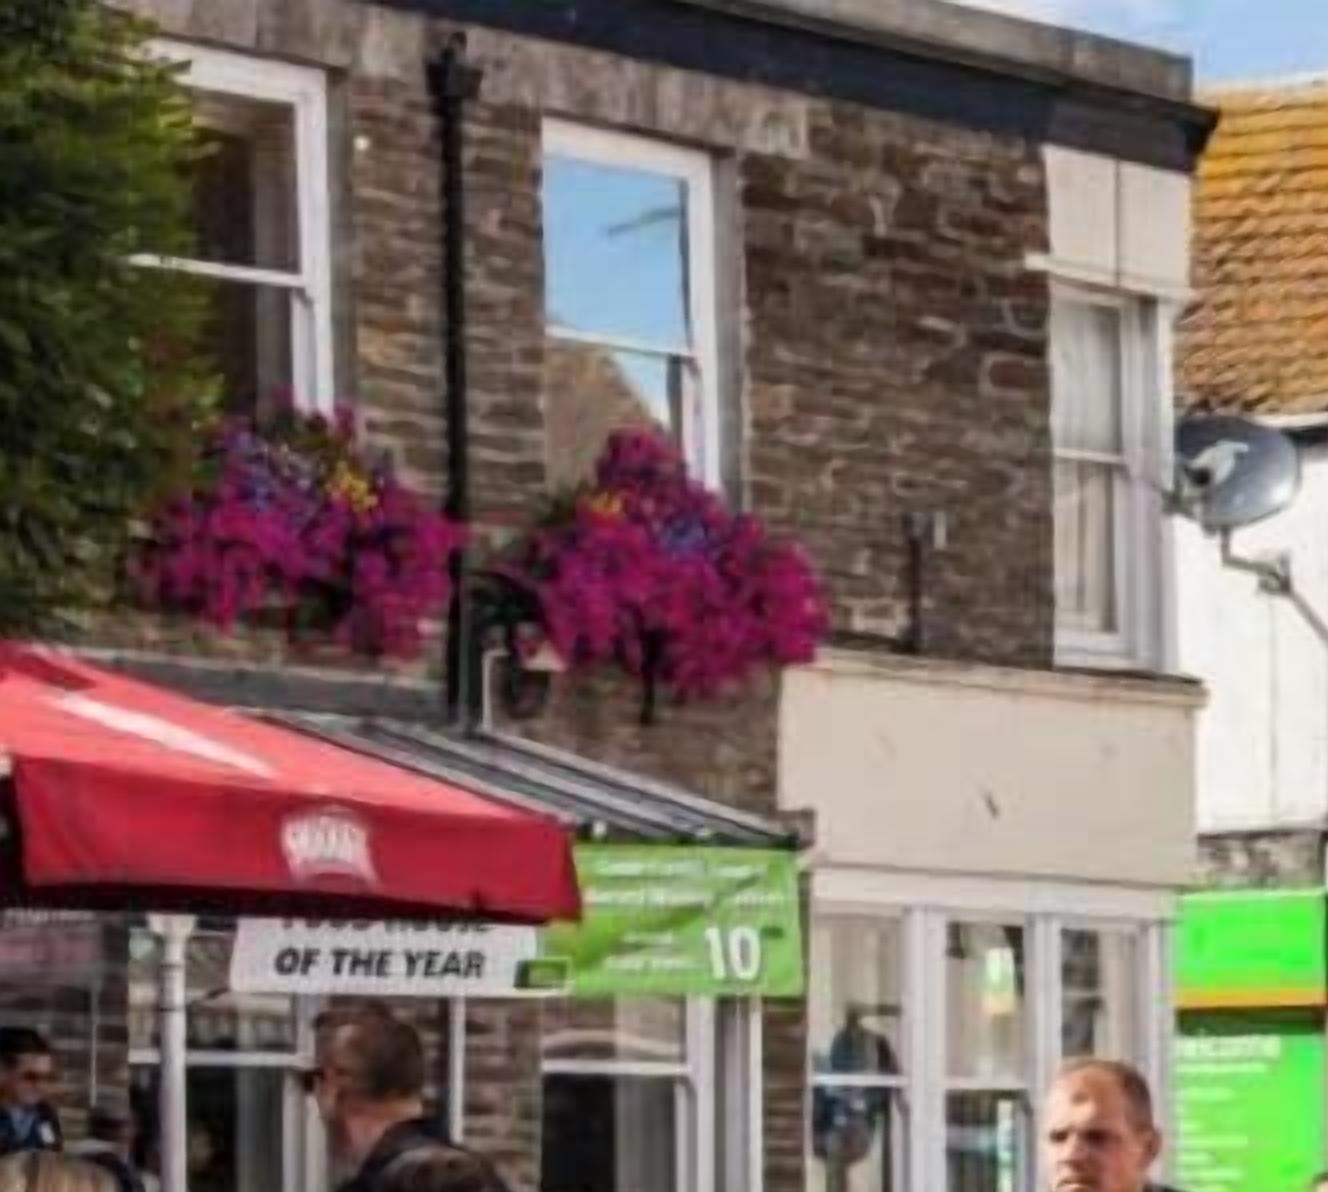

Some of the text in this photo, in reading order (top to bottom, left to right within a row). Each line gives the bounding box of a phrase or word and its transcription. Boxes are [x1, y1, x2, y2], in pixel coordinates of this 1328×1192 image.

[274, 946, 486, 979] OF THE YEAR
[704, 926, 763, 981] 10
